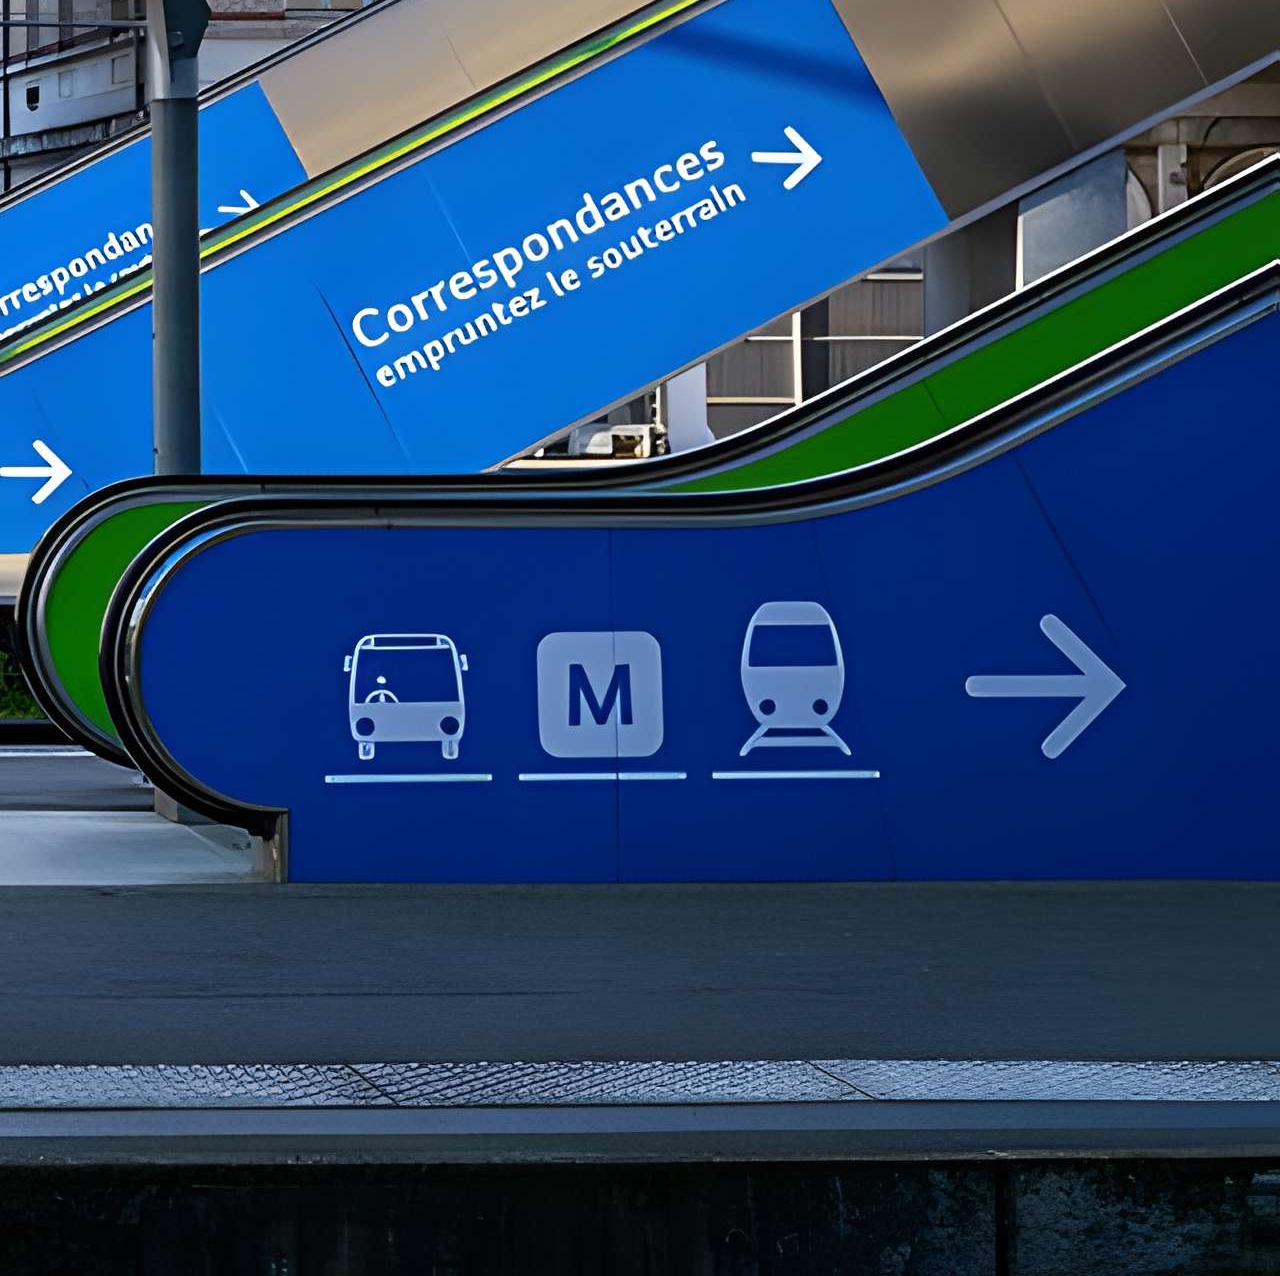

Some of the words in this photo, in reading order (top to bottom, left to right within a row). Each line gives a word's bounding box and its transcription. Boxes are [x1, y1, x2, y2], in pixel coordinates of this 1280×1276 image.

[351, 140, 725, 349] Correspondances
[376, 286, 548, 389] empruntez
[545, 267, 581, 297] le
[586, 183, 747, 280] souterrain
[568, 663, 633, 726] M
